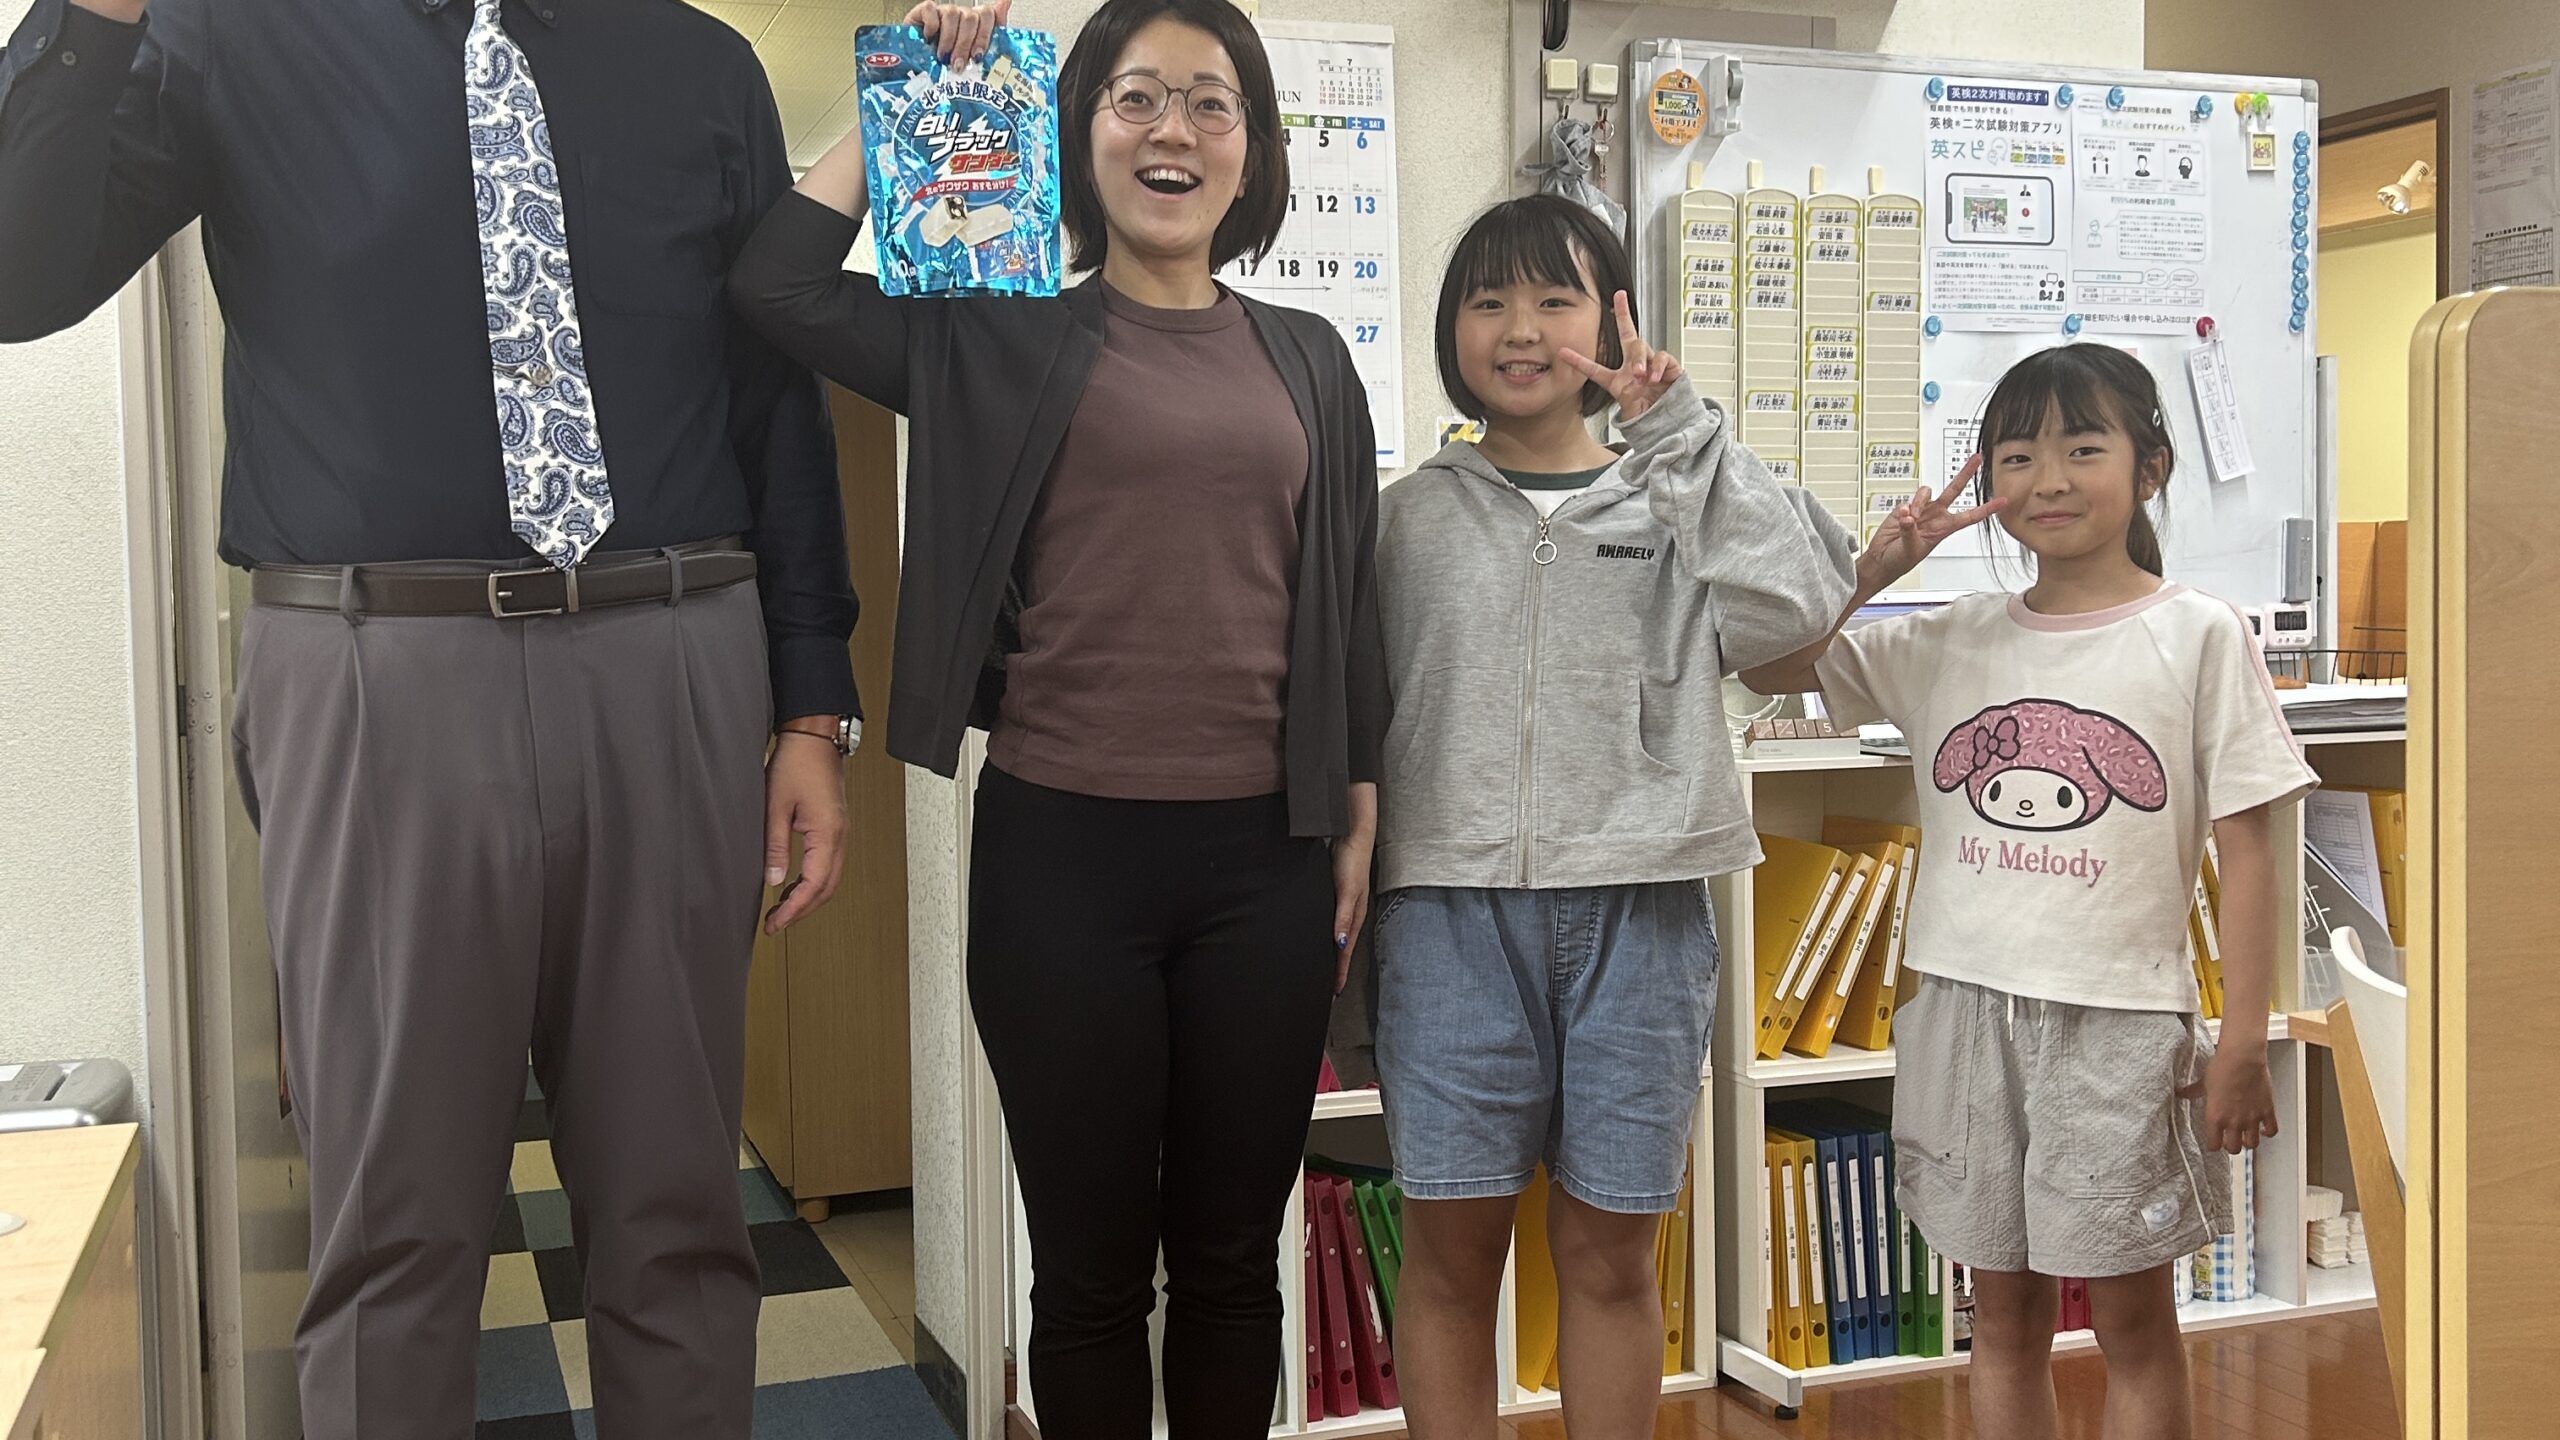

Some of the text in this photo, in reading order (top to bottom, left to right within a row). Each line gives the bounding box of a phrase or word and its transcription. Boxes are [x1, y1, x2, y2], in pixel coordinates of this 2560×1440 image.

[1951, 87, 2048, 103] 英検2次対策始めます！
[914, 112, 960, 137] 白い
[926, 129, 1011, 164] ブラック
[1319, 130, 1330, 148] 5
[1356, 131, 1368, 149] 6
[1931, 139, 1985, 160] 英スピ
[1316, 195, 1338, 213] 12
[1354, 196, 1376, 215] 13
[1239, 259, 1378, 279] 17 18 19 20
[1355, 325, 1380, 343] 27
[1802, 722, 1832, 734] 1 5
[1958, 836, 2107, 888] My Melody
